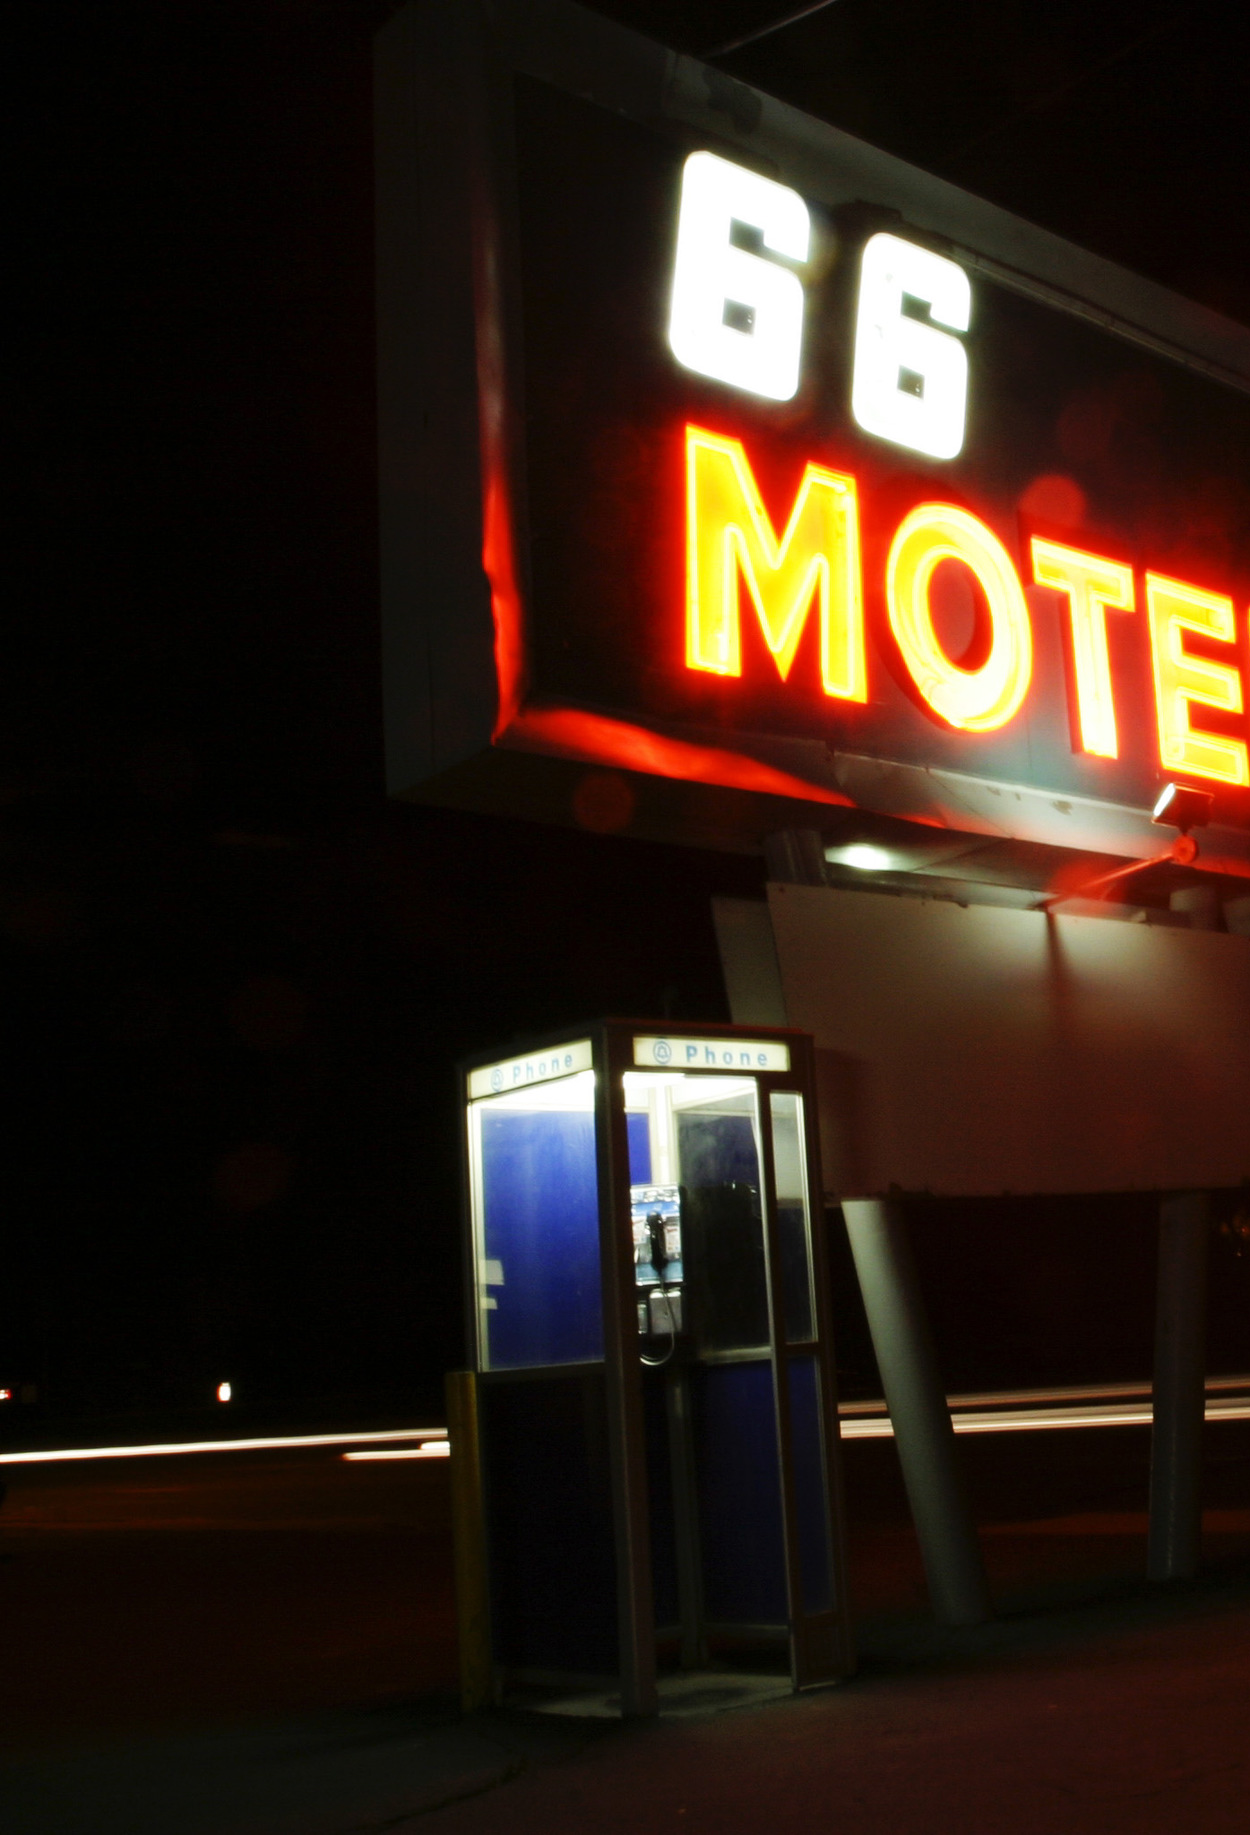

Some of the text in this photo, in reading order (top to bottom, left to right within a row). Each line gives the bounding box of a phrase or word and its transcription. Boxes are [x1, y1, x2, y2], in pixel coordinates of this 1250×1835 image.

[668, 150, 972, 461] 66
[512, 1053, 574, 1084] Phone
[685, 1045, 768, 1067] Phone
